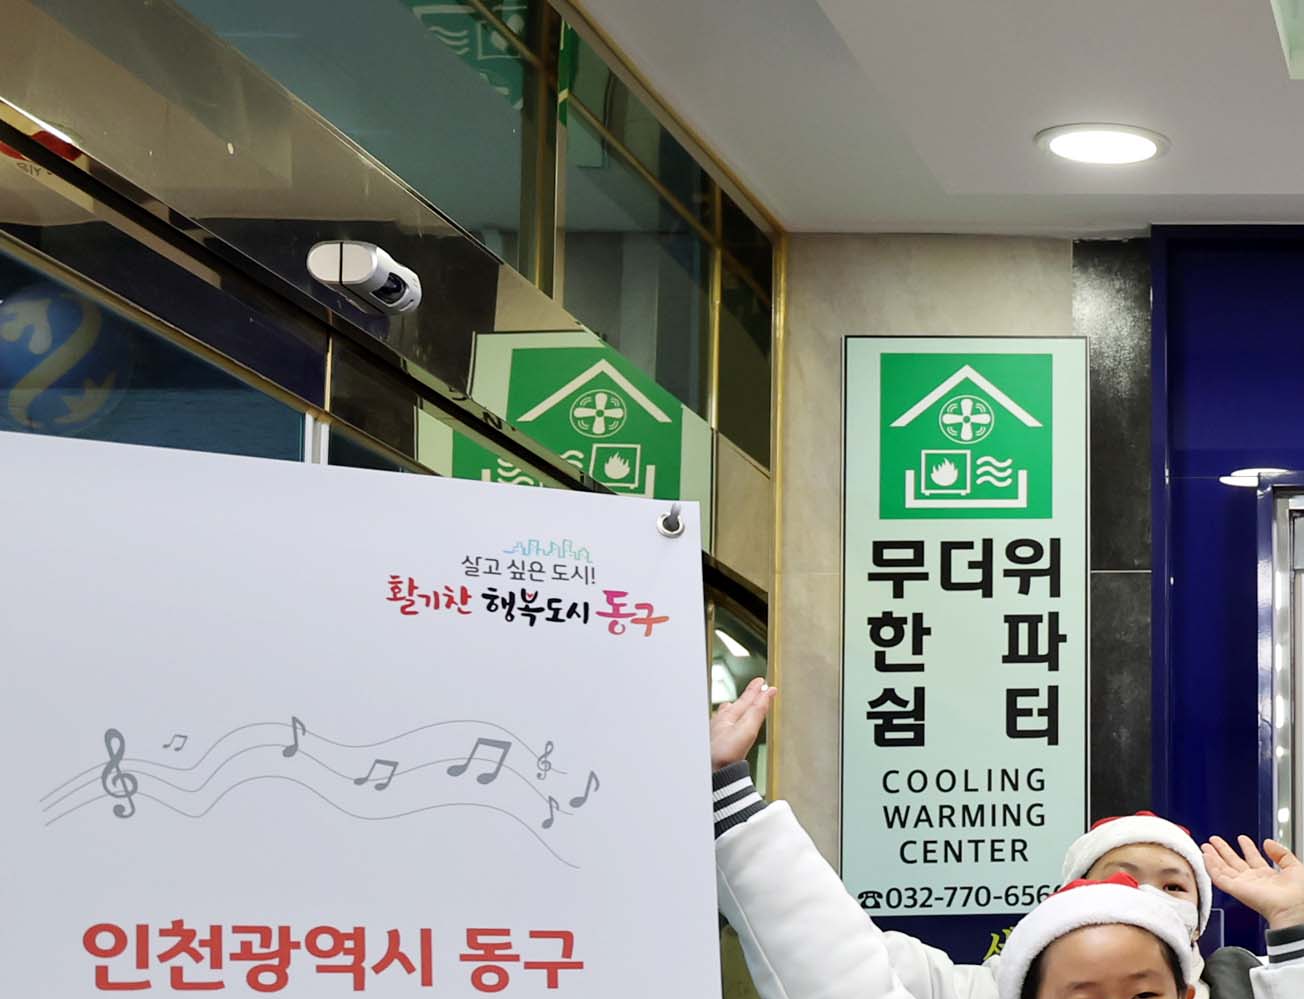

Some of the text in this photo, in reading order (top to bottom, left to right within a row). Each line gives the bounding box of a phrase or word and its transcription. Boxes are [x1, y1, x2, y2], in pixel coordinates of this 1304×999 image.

[461, 555, 597, 585] 살고 싶은 도시!
[866, 536, 1063, 600] 무더위
[385, 574, 670, 637] 활기찬 행복도시 동구
[882, 767, 1046, 794] COOLING
[883, 803, 1046, 829] WARMING
[900, 839, 1030, 865] CENTER
[885, 884, 1062, 910] 032-770-656
[81, 919, 585, 994] 인천광역시 동구
